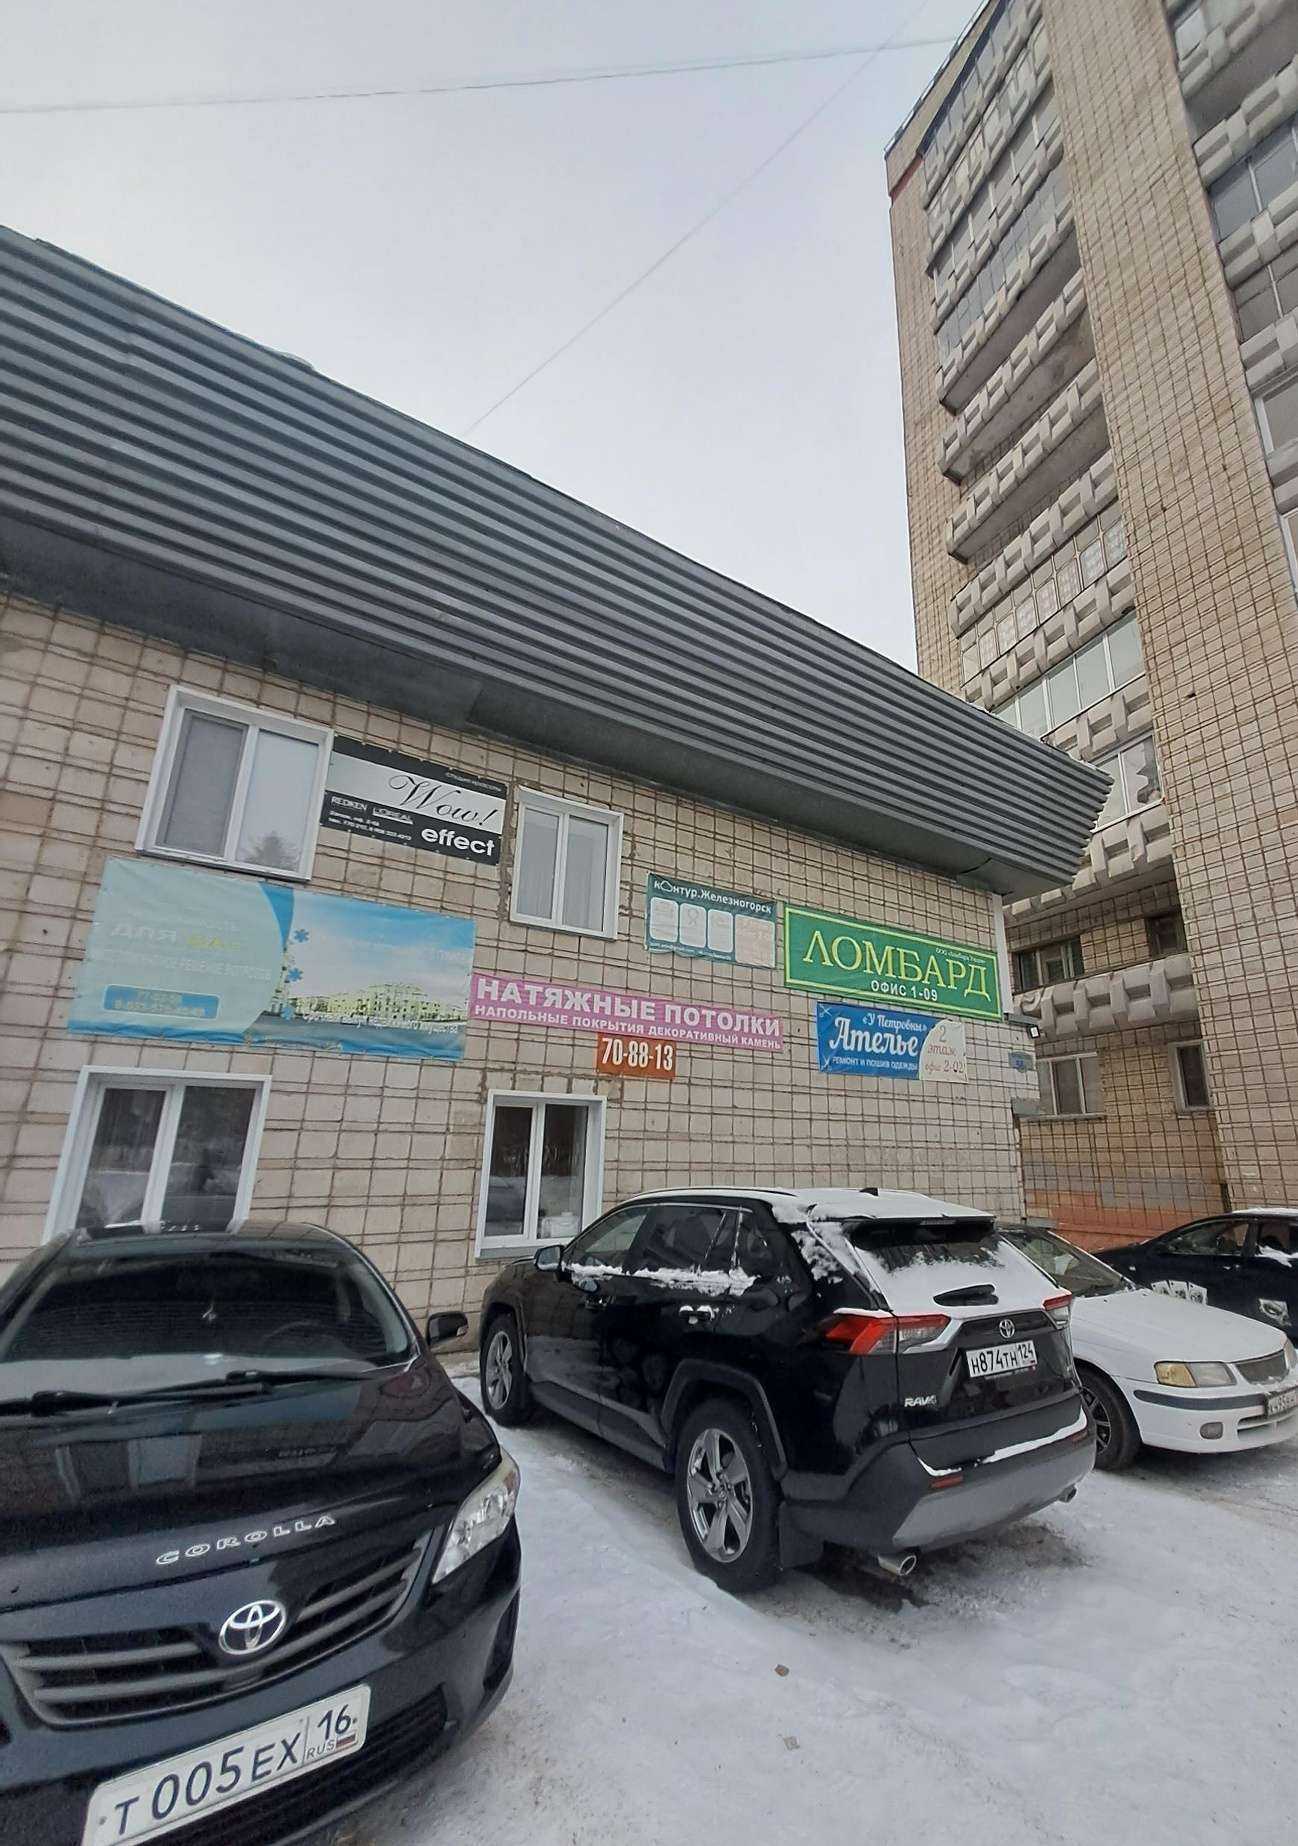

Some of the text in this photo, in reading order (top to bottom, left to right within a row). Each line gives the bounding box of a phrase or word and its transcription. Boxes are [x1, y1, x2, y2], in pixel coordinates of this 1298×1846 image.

[388, 775, 498, 826] Wow!
[421, 828, 495, 856] effect
[802, 930, 991, 1002] ЛОМБАРД
[476, 978, 780, 1037] НАТЯЖНЫЕ ПОТОЛКИ
[871, 980, 938, 1001] ОФИС 1-09
[474, 1005, 781, 1049] НАПОЛЬНЫЕ ПОКРЫТИЯ ДЕКОРАТИВНЫЙ КАМЕНЬ
[829, 1016, 919, 1057] Ателье
[602, 1037, 673, 1071] 70-88-13
[156, 1515, 336, 1565] COROLLA
[317, 1703, 352, 1741] 16
[307, 1740, 335, 1761] RUS
